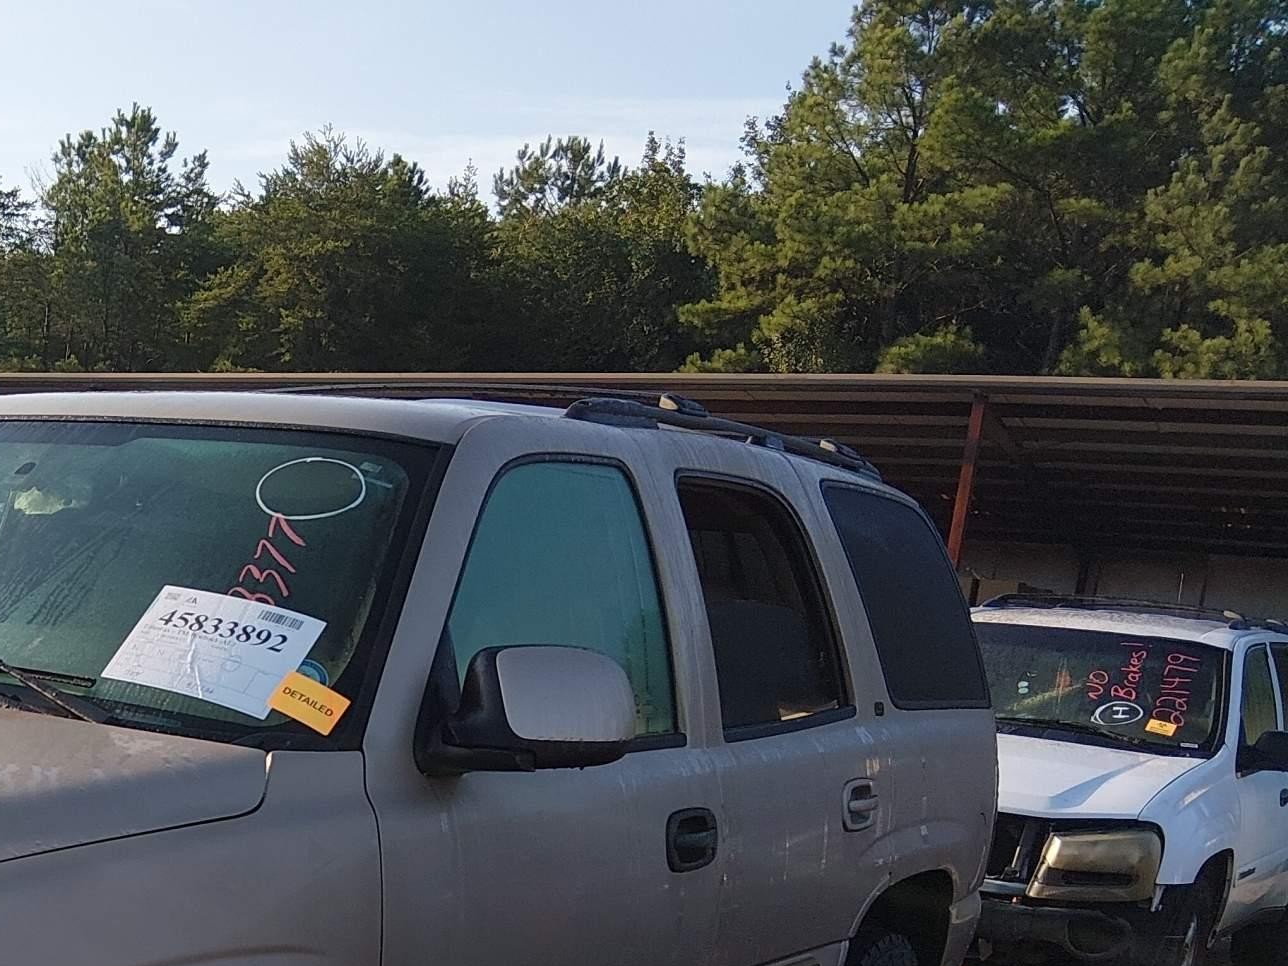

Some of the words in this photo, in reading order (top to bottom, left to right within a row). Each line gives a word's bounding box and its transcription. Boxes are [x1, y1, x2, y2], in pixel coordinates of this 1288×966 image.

[158, 608, 288, 654] 45833892
[281, 687, 334, 718] DETAILED
[1152, 653, 1201, 727] 221479
